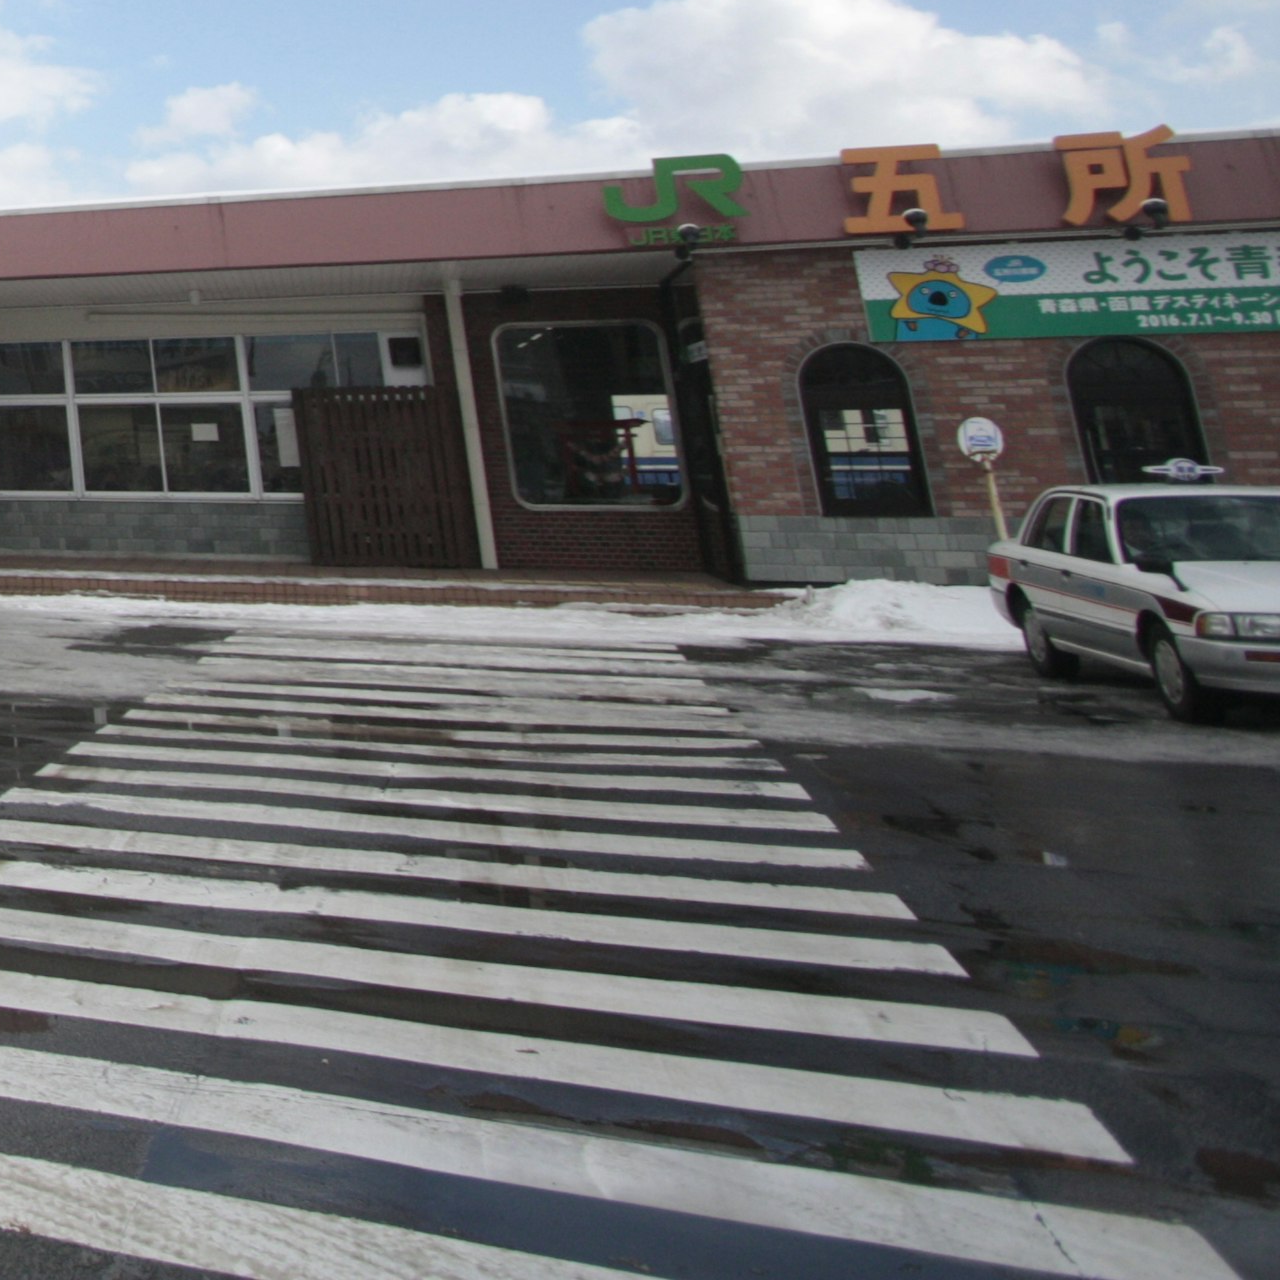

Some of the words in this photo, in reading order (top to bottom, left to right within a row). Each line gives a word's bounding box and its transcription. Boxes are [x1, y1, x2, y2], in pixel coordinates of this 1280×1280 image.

[602, 153, 752, 223] JR
[1083, 244, 1280, 284] ようこそ青
